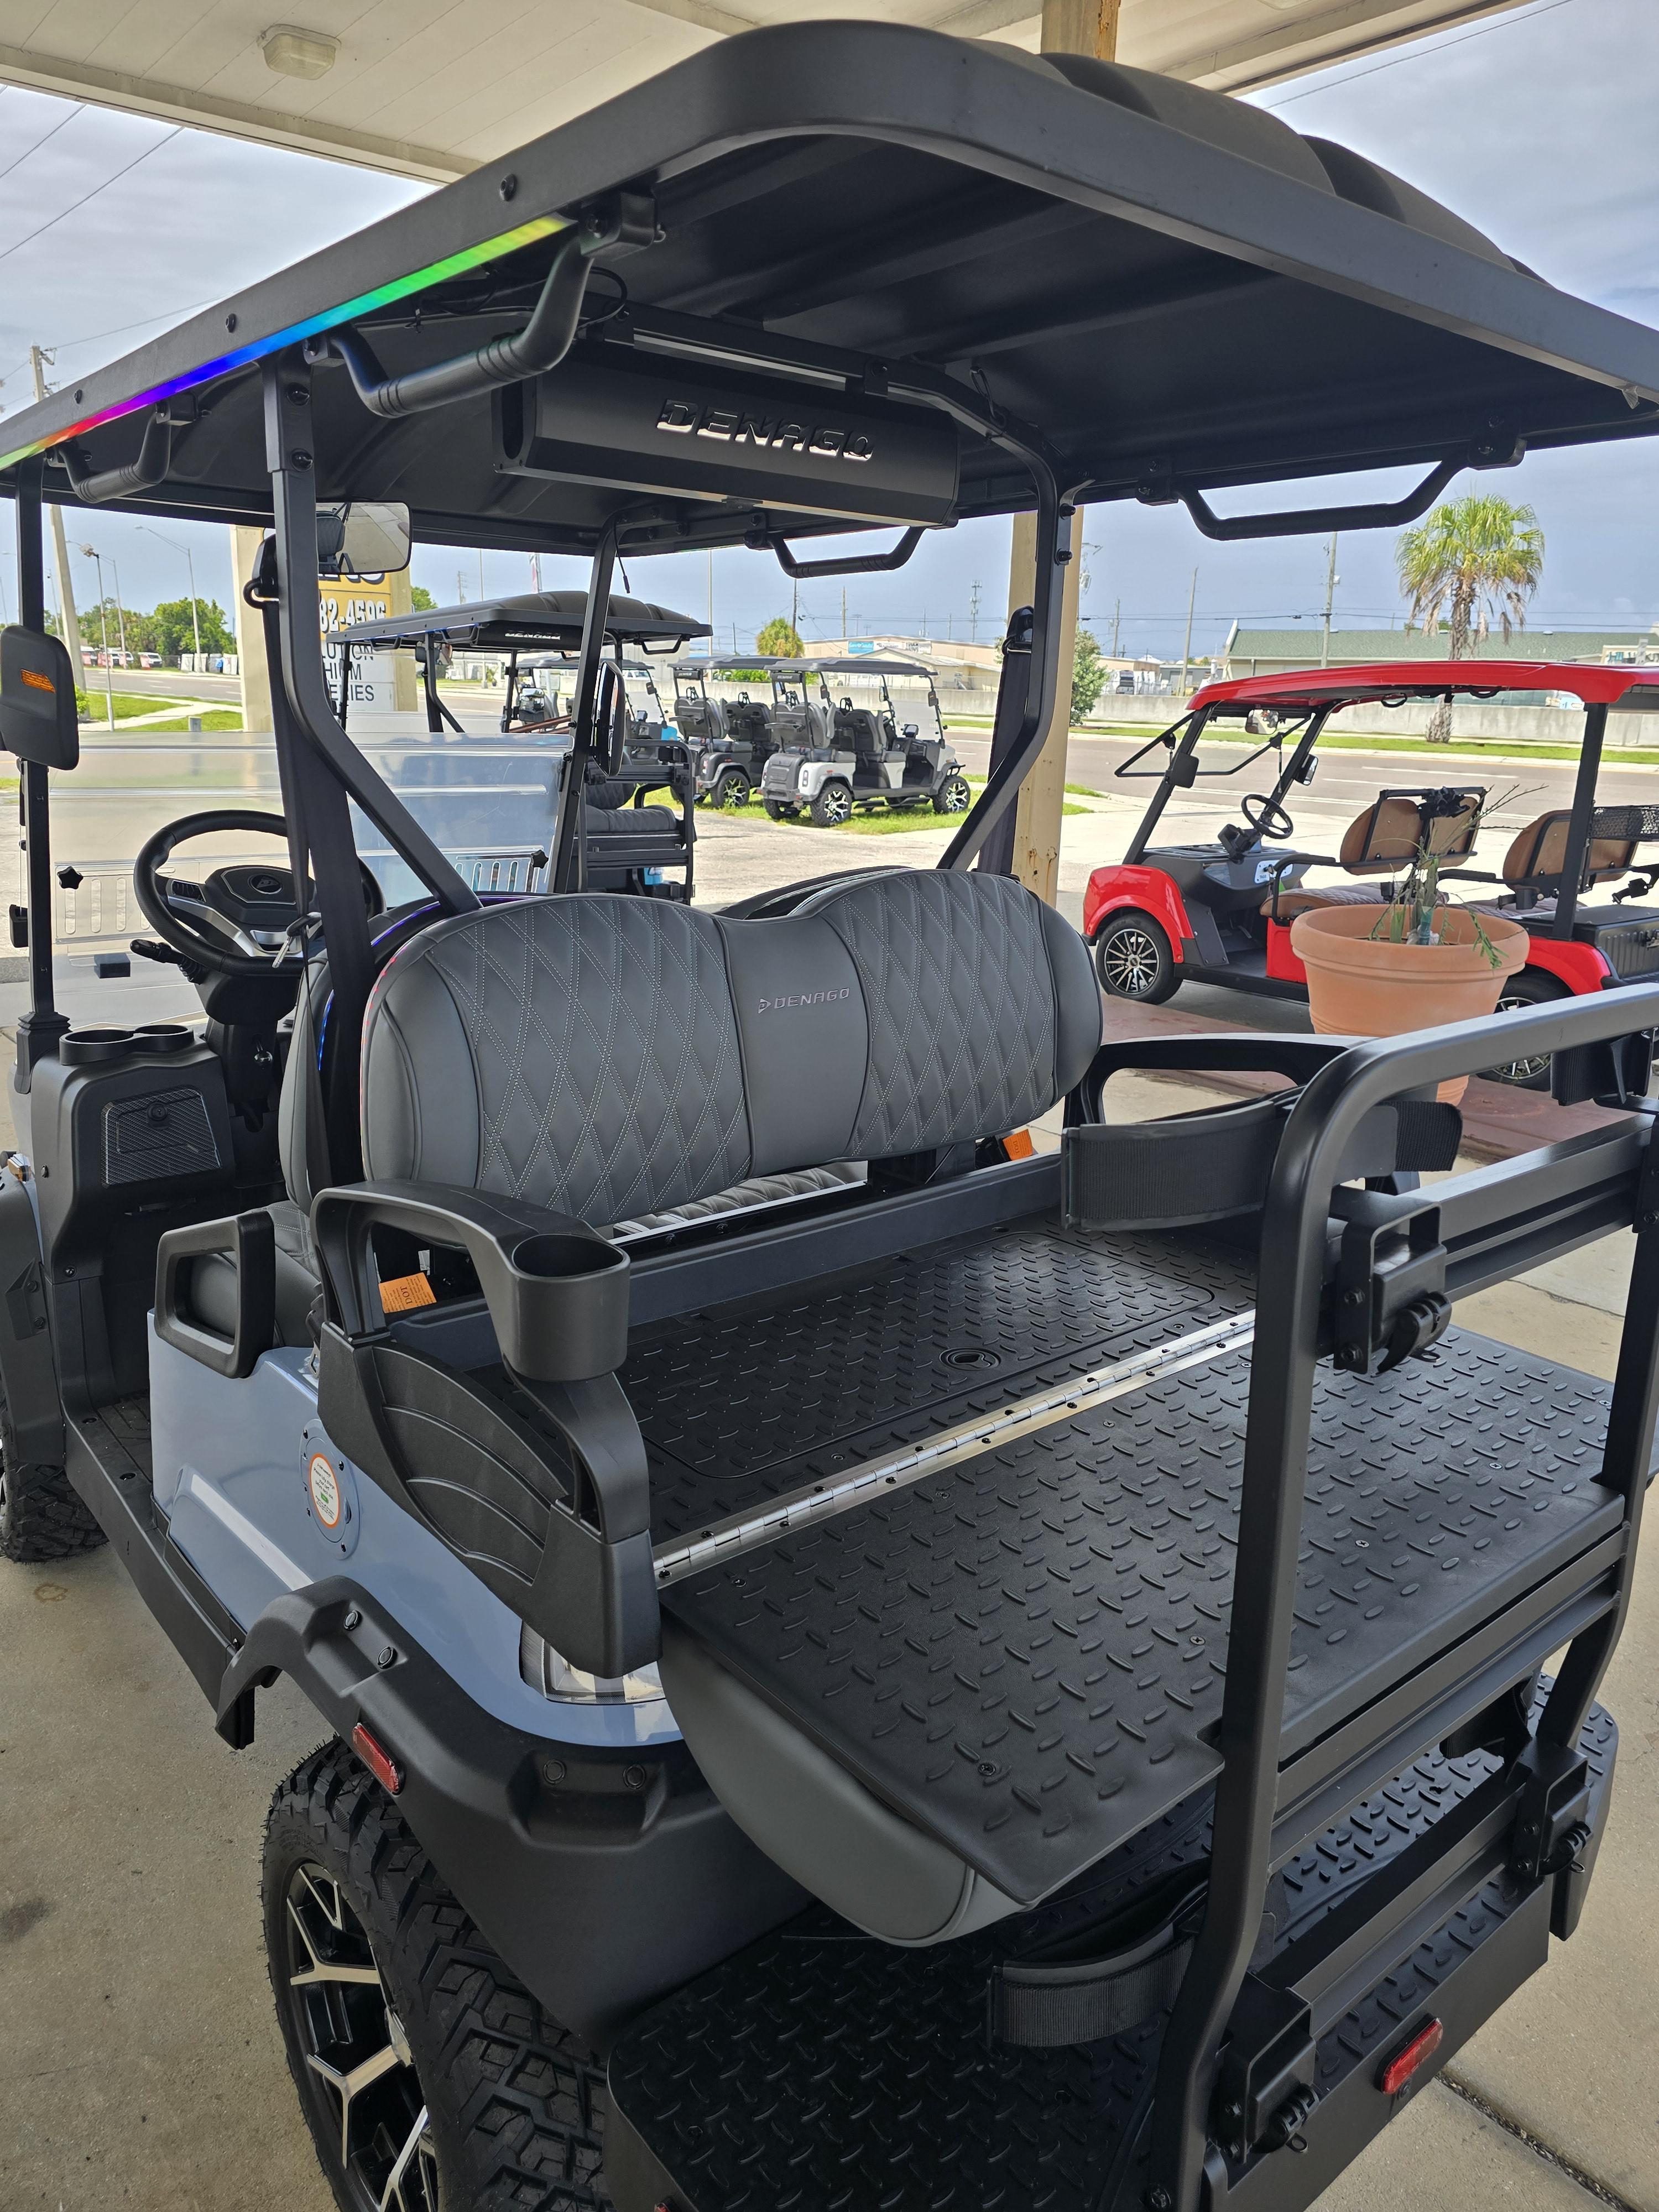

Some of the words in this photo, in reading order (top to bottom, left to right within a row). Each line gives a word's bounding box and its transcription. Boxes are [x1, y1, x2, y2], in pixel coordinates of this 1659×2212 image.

[656, 398, 876, 461] DENAGO
[325, 662, 362, 680] HIM
[330, 685, 374, 701] EIES
[774, 987, 850, 1010] DENAGO
[400, 1286, 413, 1305] DOT
